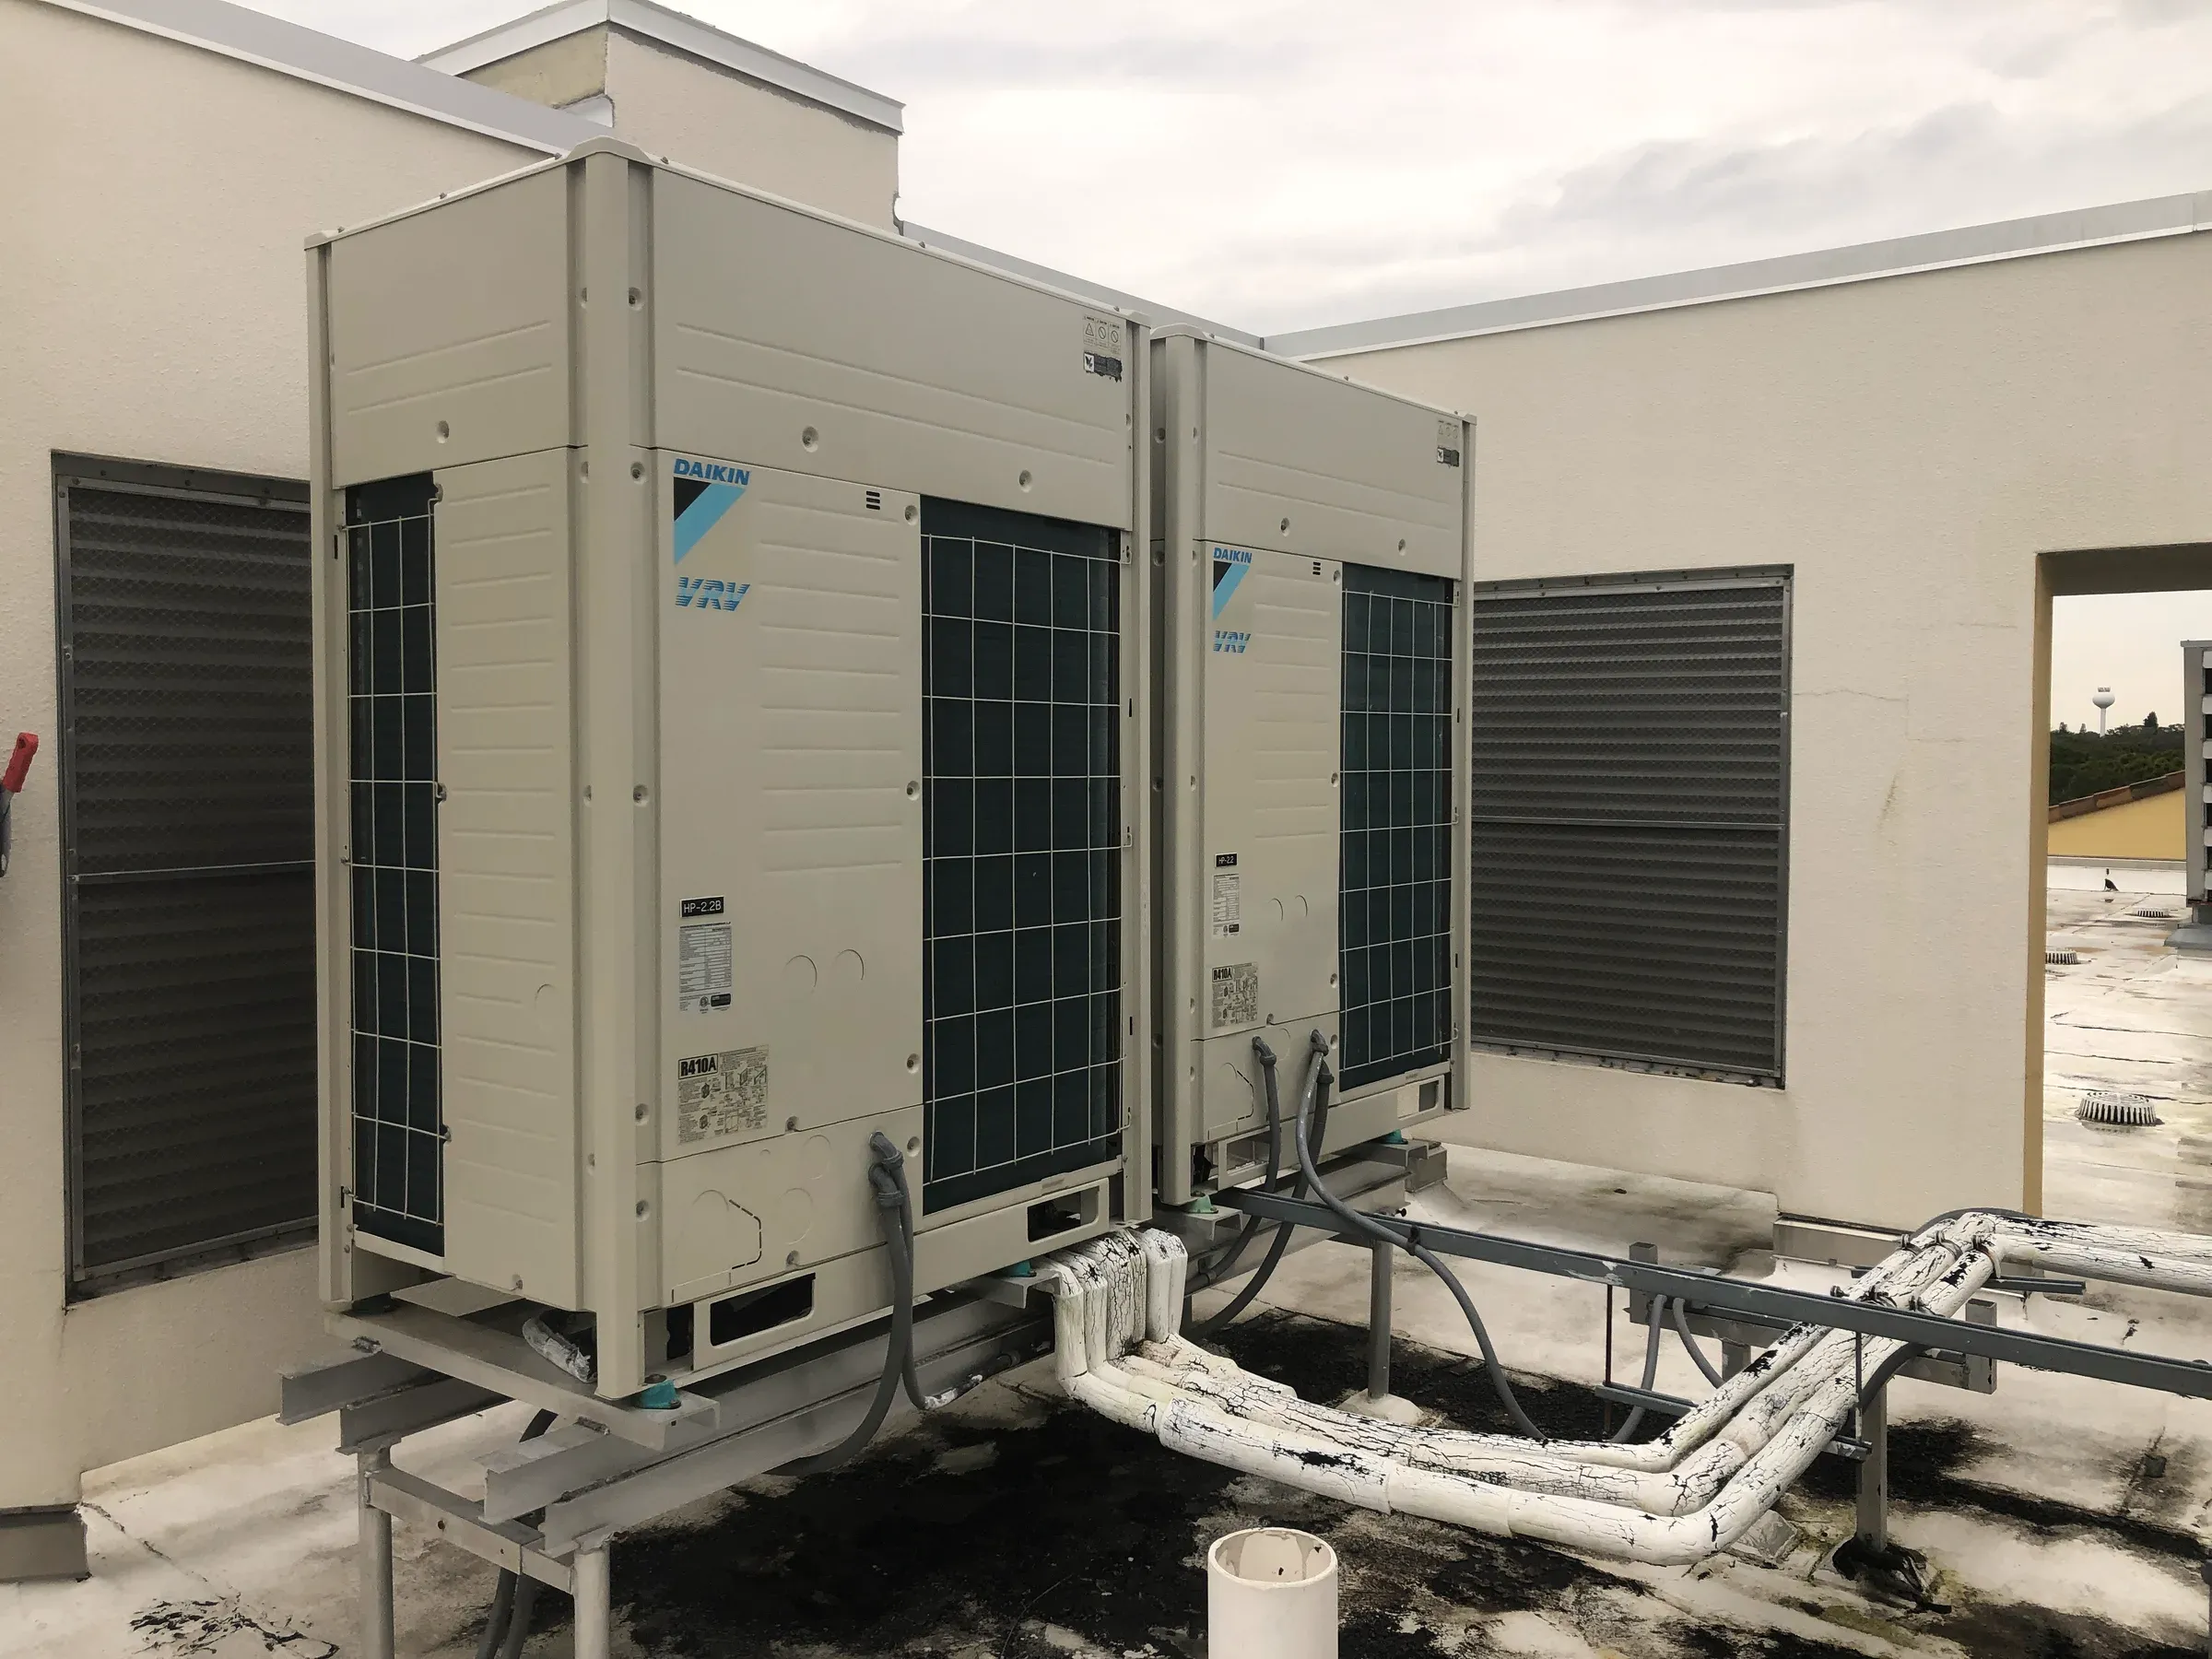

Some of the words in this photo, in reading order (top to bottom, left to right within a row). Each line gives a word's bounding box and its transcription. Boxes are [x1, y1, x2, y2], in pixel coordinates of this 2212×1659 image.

[674, 458, 750, 486] DAIKIN
[1213, 547, 1253, 563] DAIKIN
[675, 576, 751, 612] VRV
[1213, 630, 1252, 653] VRV
[683, 900, 722, 913] HP-2.2B
[1213, 968, 1232, 980] R410A
[680, 1056, 717, 1077] R410A
